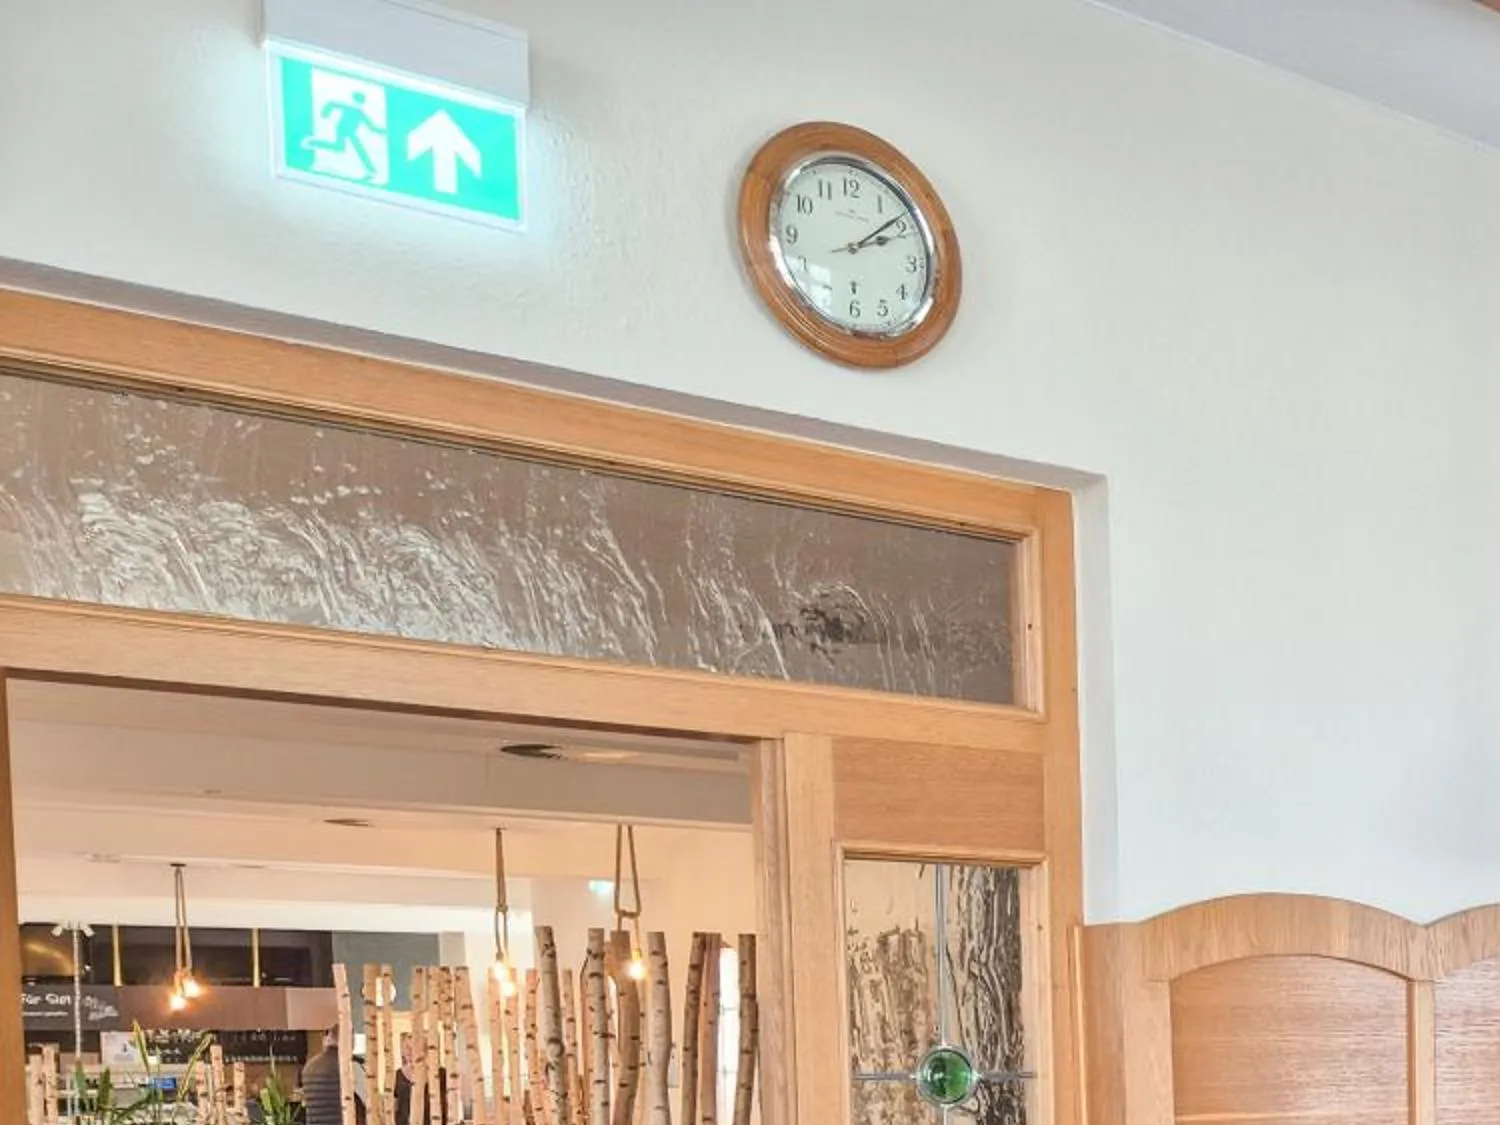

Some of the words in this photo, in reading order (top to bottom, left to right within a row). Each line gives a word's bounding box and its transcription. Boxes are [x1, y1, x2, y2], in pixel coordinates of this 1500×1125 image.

[818, 179, 832, 200] 11
[843, 177, 860, 198] 12
[796, 194, 813, 215] 10
[785, 224, 798, 244] 9
[895, 219, 907, 239] 2
[906, 255, 917, 272] 3
[849, 300, 861, 318] 6
[876, 299, 889, 317] 5
